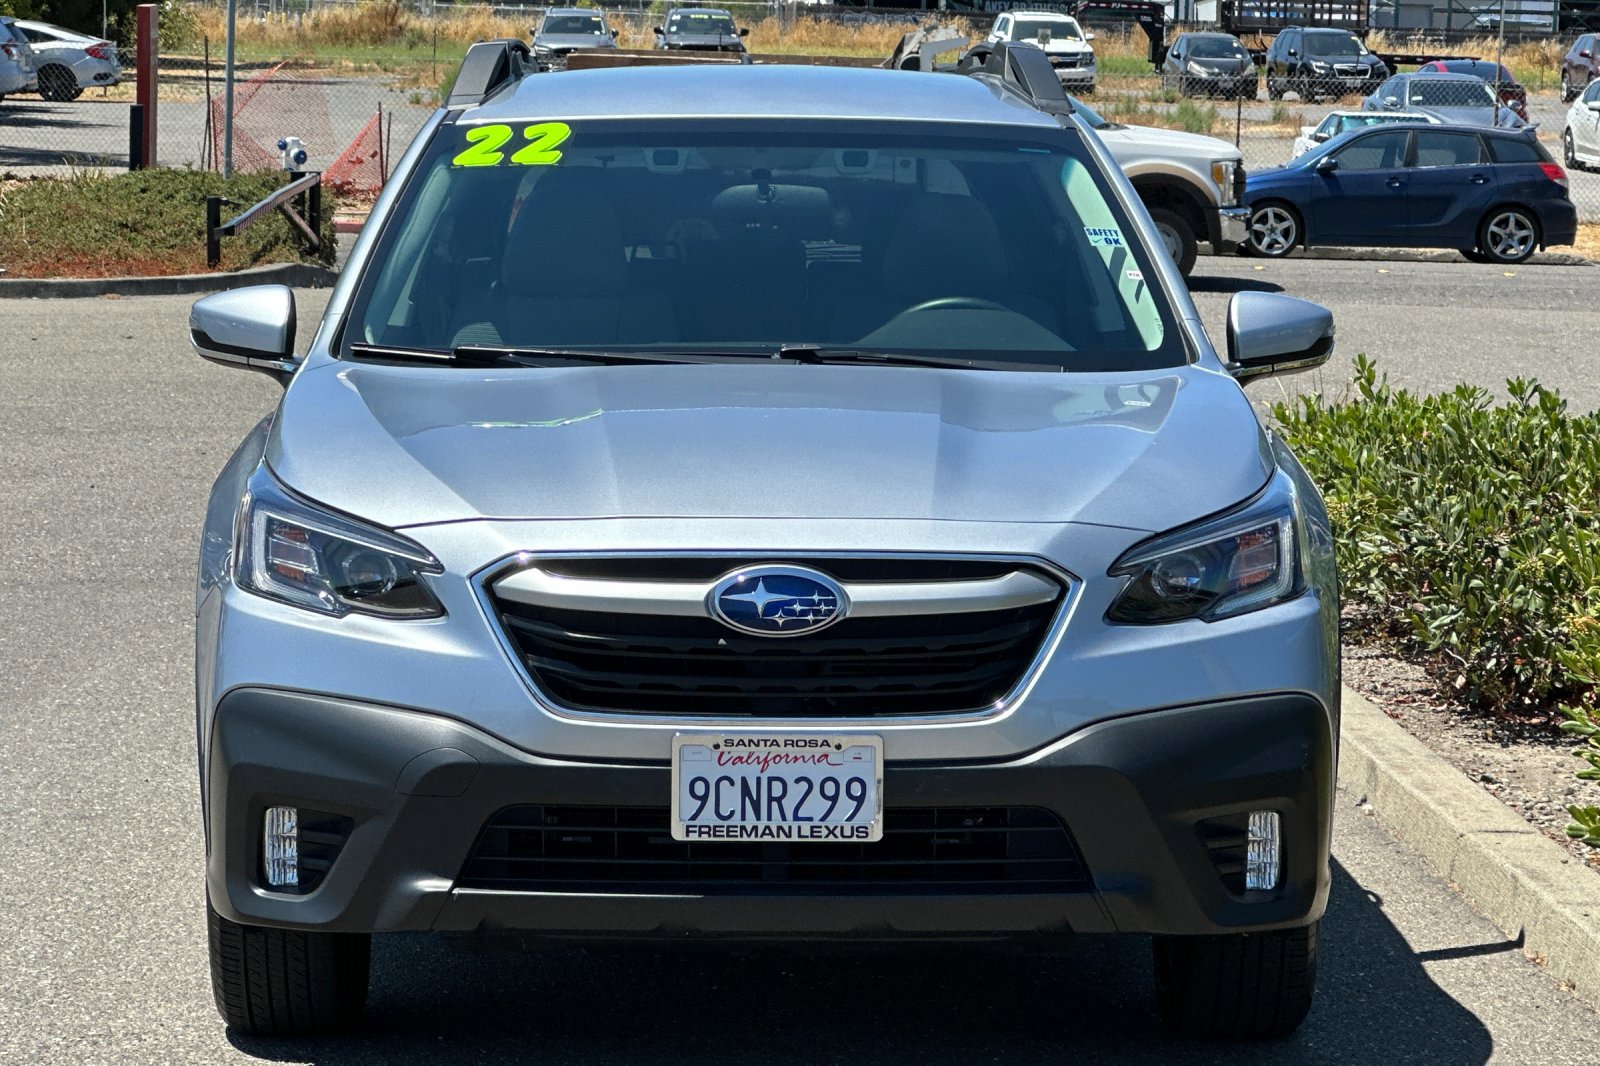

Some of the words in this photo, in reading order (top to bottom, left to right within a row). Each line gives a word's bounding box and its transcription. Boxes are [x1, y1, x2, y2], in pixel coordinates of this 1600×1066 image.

[452, 122, 572, 167] 22
[1086, 228, 1119, 237] SAFETY
[1104, 237, 1122, 245] OK
[723, 738, 780, 748] SANTA
[783, 738, 832, 748] ROSA
[717, 751, 843, 773] California
[688, 775, 867, 822] 9CNR299
[685, 825, 792, 839] FREEMAN
[797, 825, 869, 839] LEXUS
